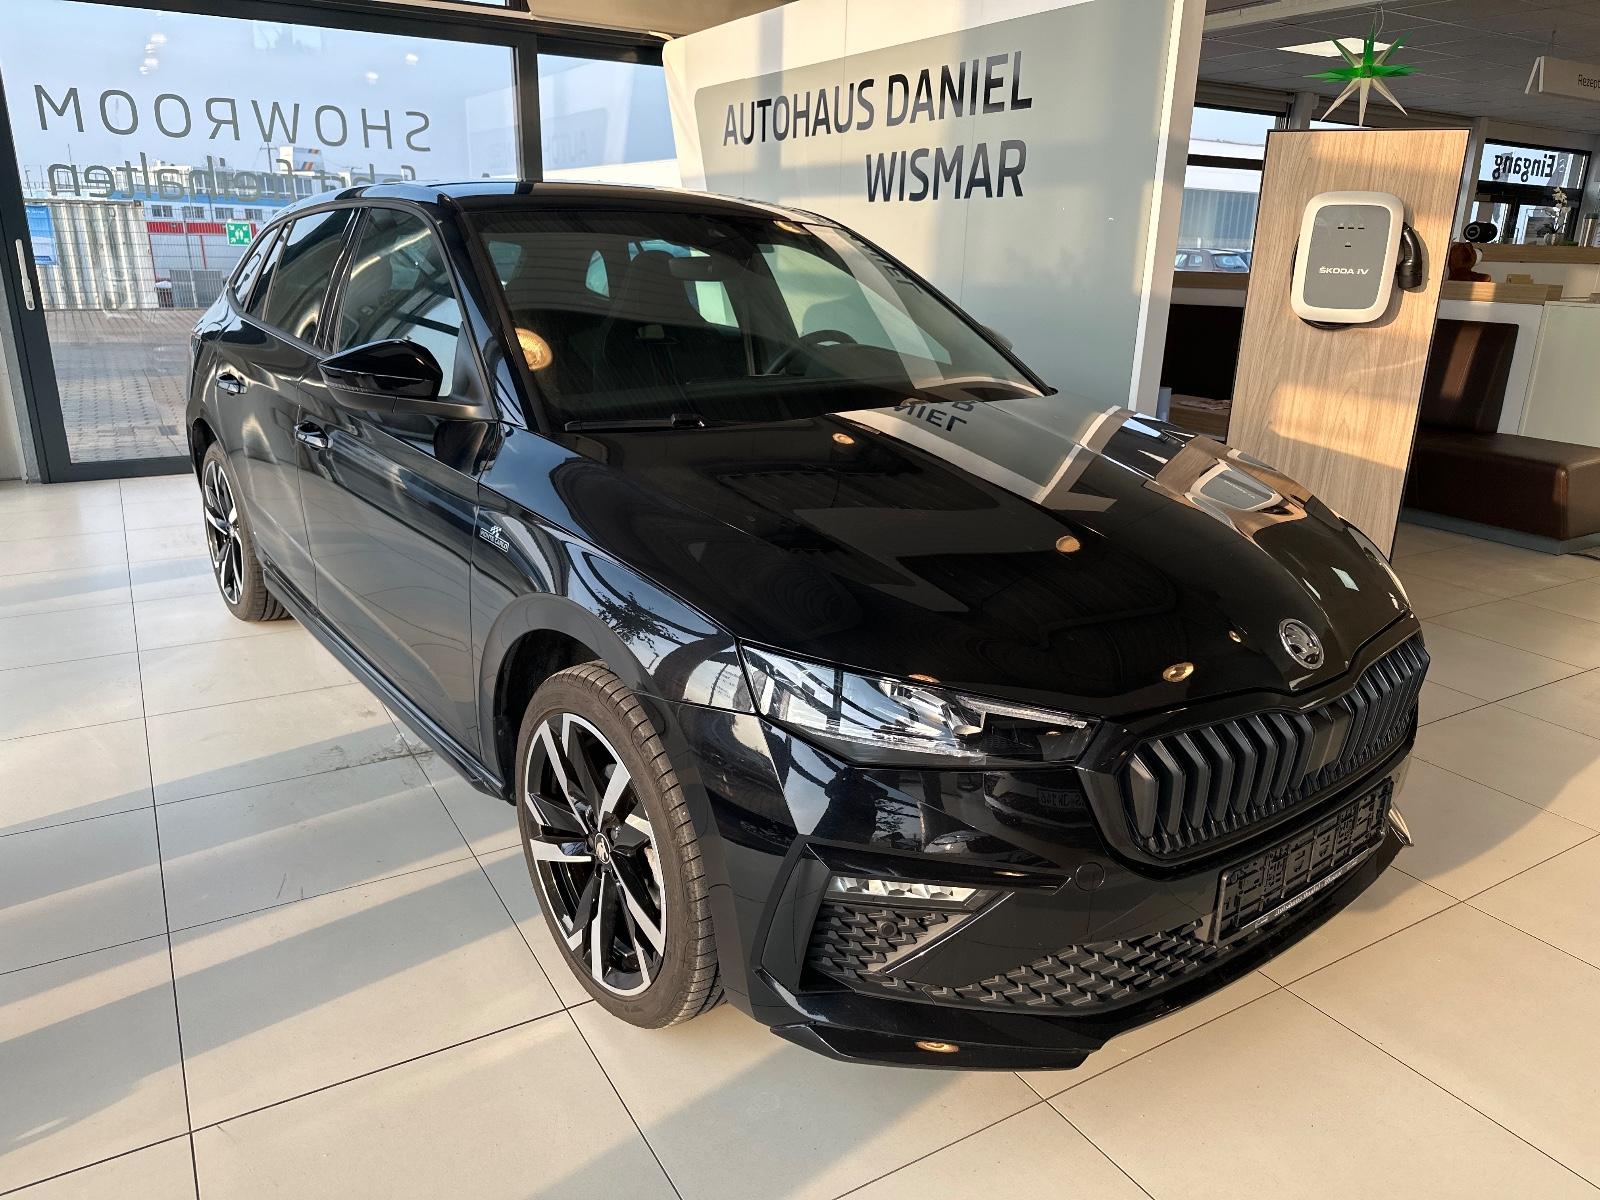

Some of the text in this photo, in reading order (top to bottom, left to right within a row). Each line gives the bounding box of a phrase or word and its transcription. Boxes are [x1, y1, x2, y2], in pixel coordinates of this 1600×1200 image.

[723, 50, 1033, 146] AUTOHAUS DANIEL
[865, 139, 1027, 203] WISMAR
[1319, 265, 1355, 275] ŠKODA
